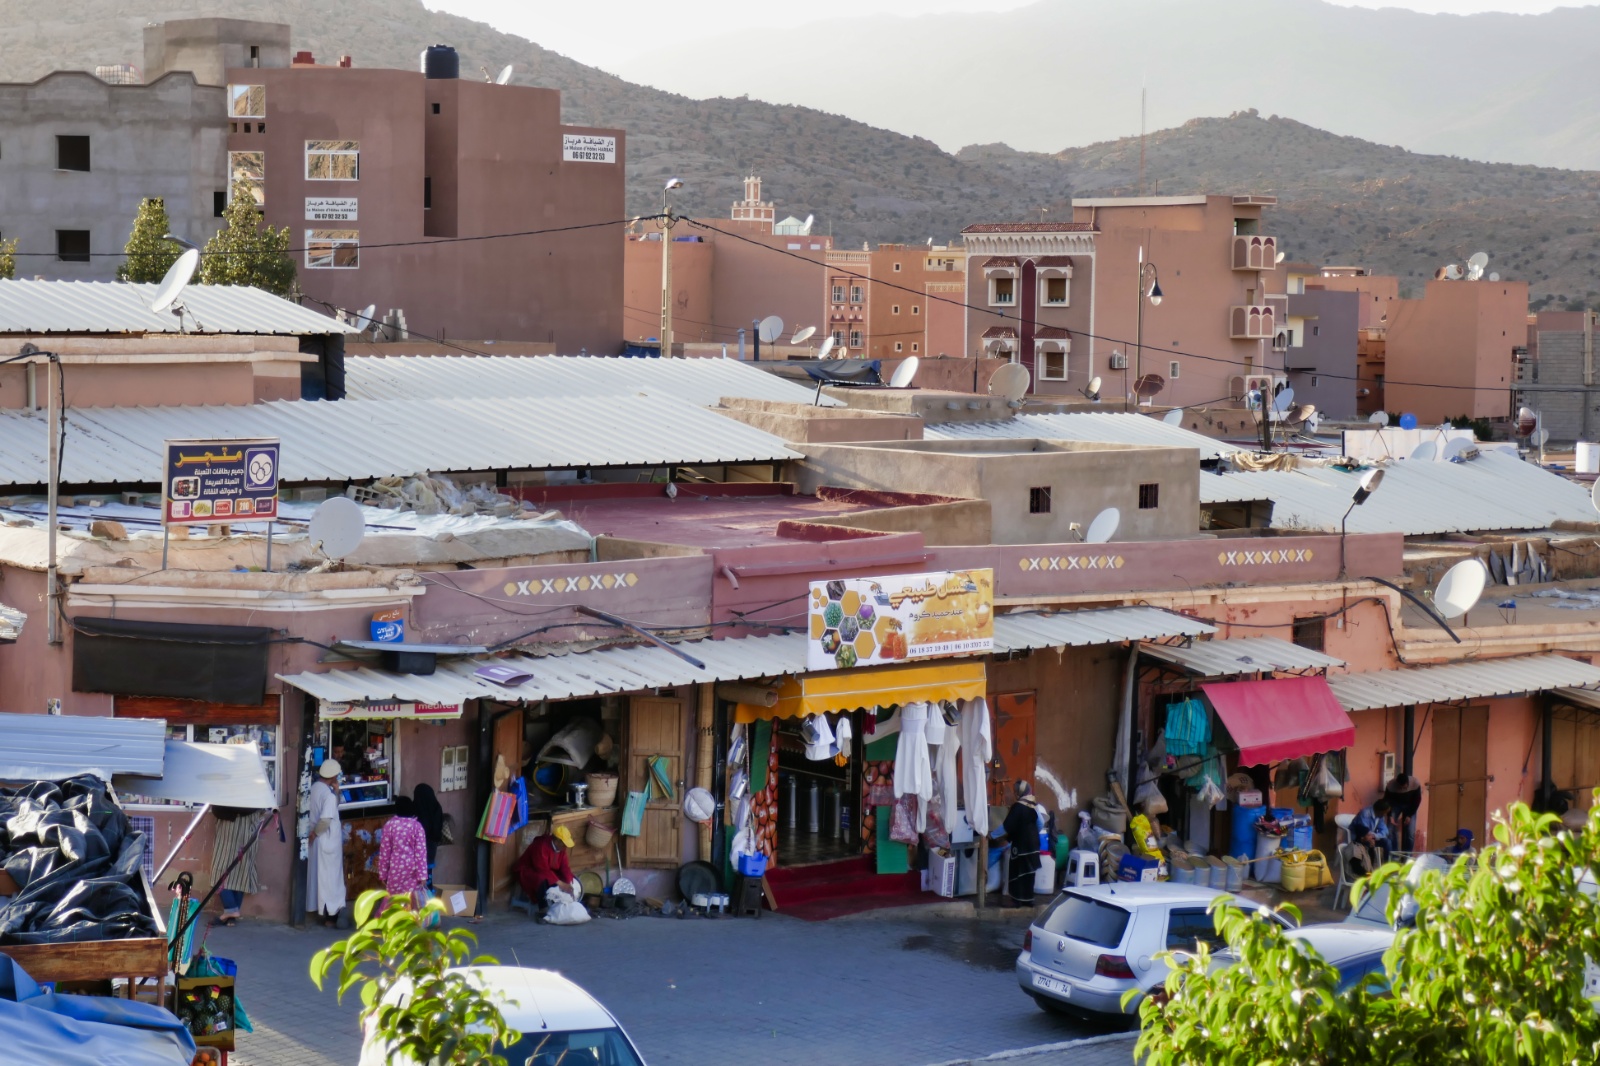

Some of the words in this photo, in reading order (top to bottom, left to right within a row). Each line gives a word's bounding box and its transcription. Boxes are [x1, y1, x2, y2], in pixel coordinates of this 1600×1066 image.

[212, 468, 230, 476] بطاقات
[205, 478, 224, 487] السريعة
[889, 577, 937, 610] طبيعي
